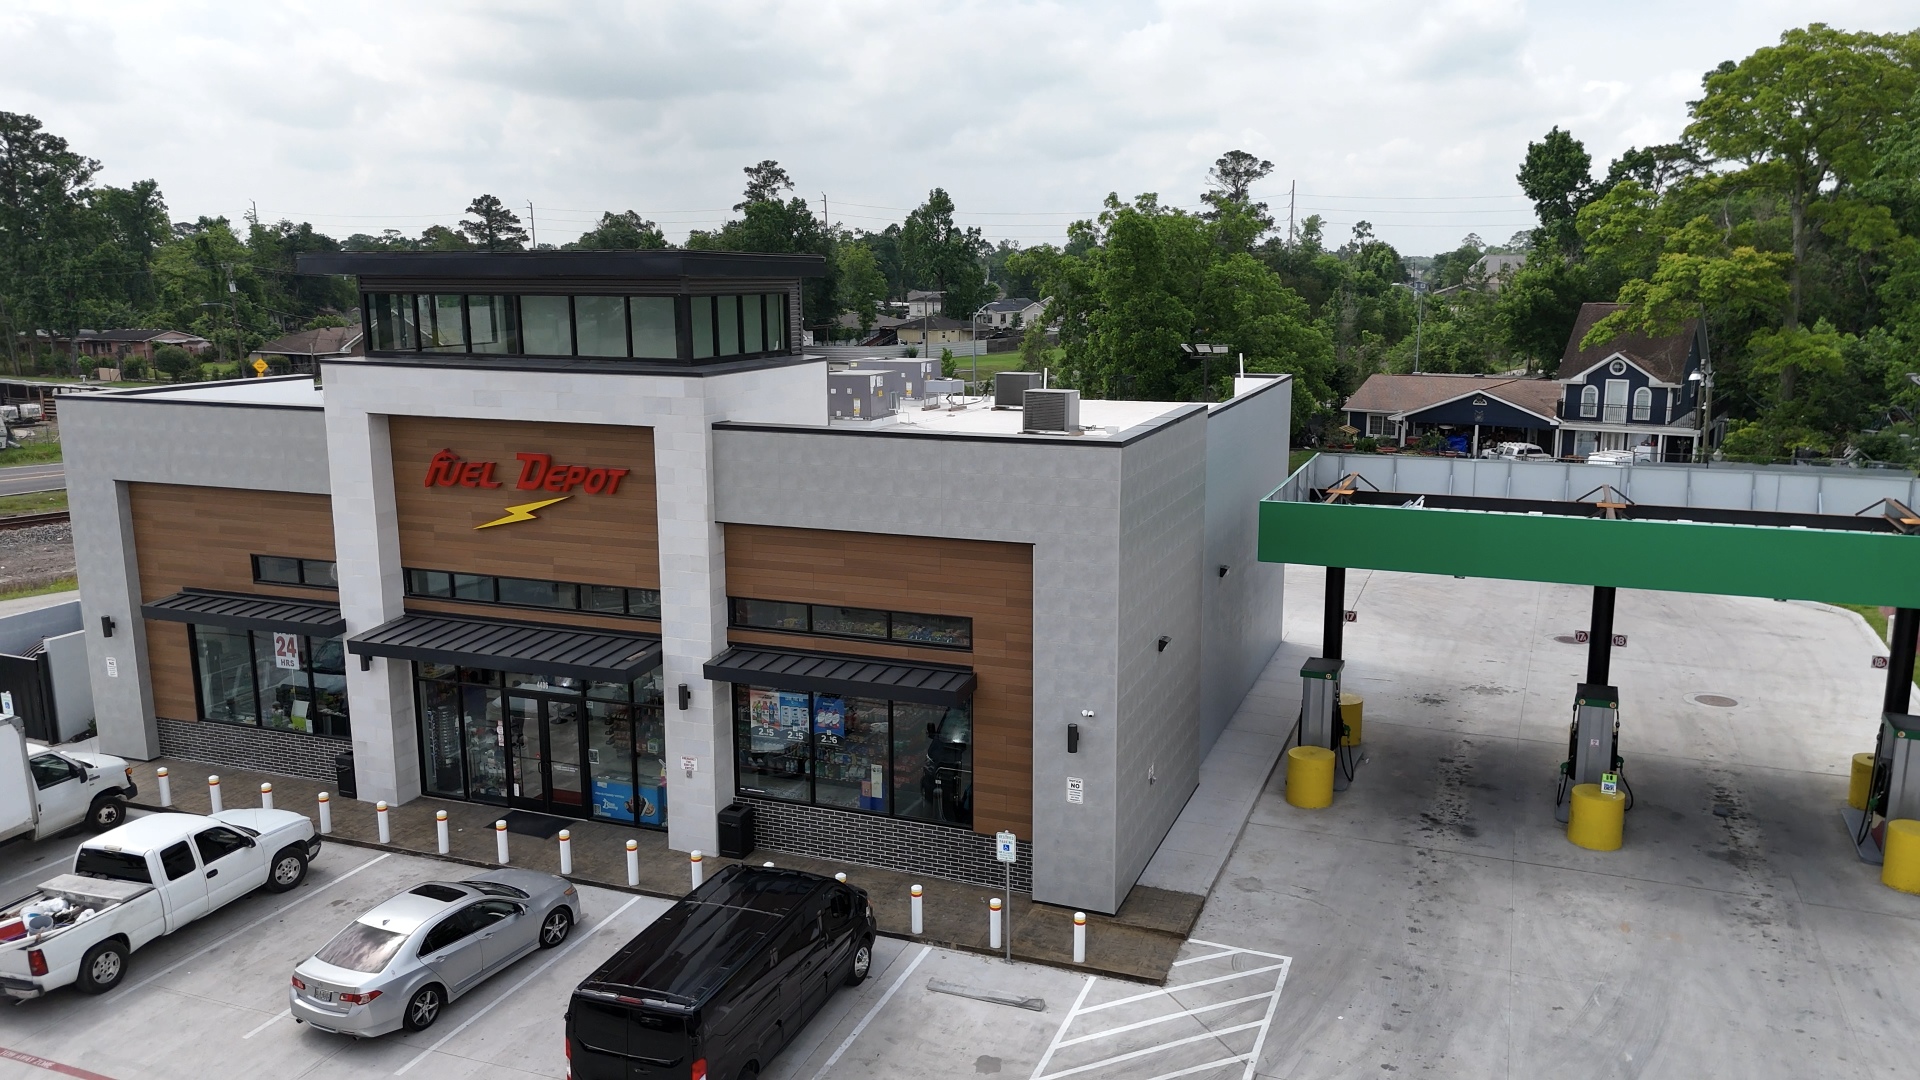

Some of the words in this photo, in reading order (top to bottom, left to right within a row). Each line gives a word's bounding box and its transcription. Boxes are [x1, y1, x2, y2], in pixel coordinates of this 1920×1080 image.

[424, 448, 503, 489] FUEL
[516, 452, 631, 495] DEPOT
[276, 635, 297, 658] 24
[1614, 636, 1625, 646] 18
[280, 658, 295, 667] HRS
